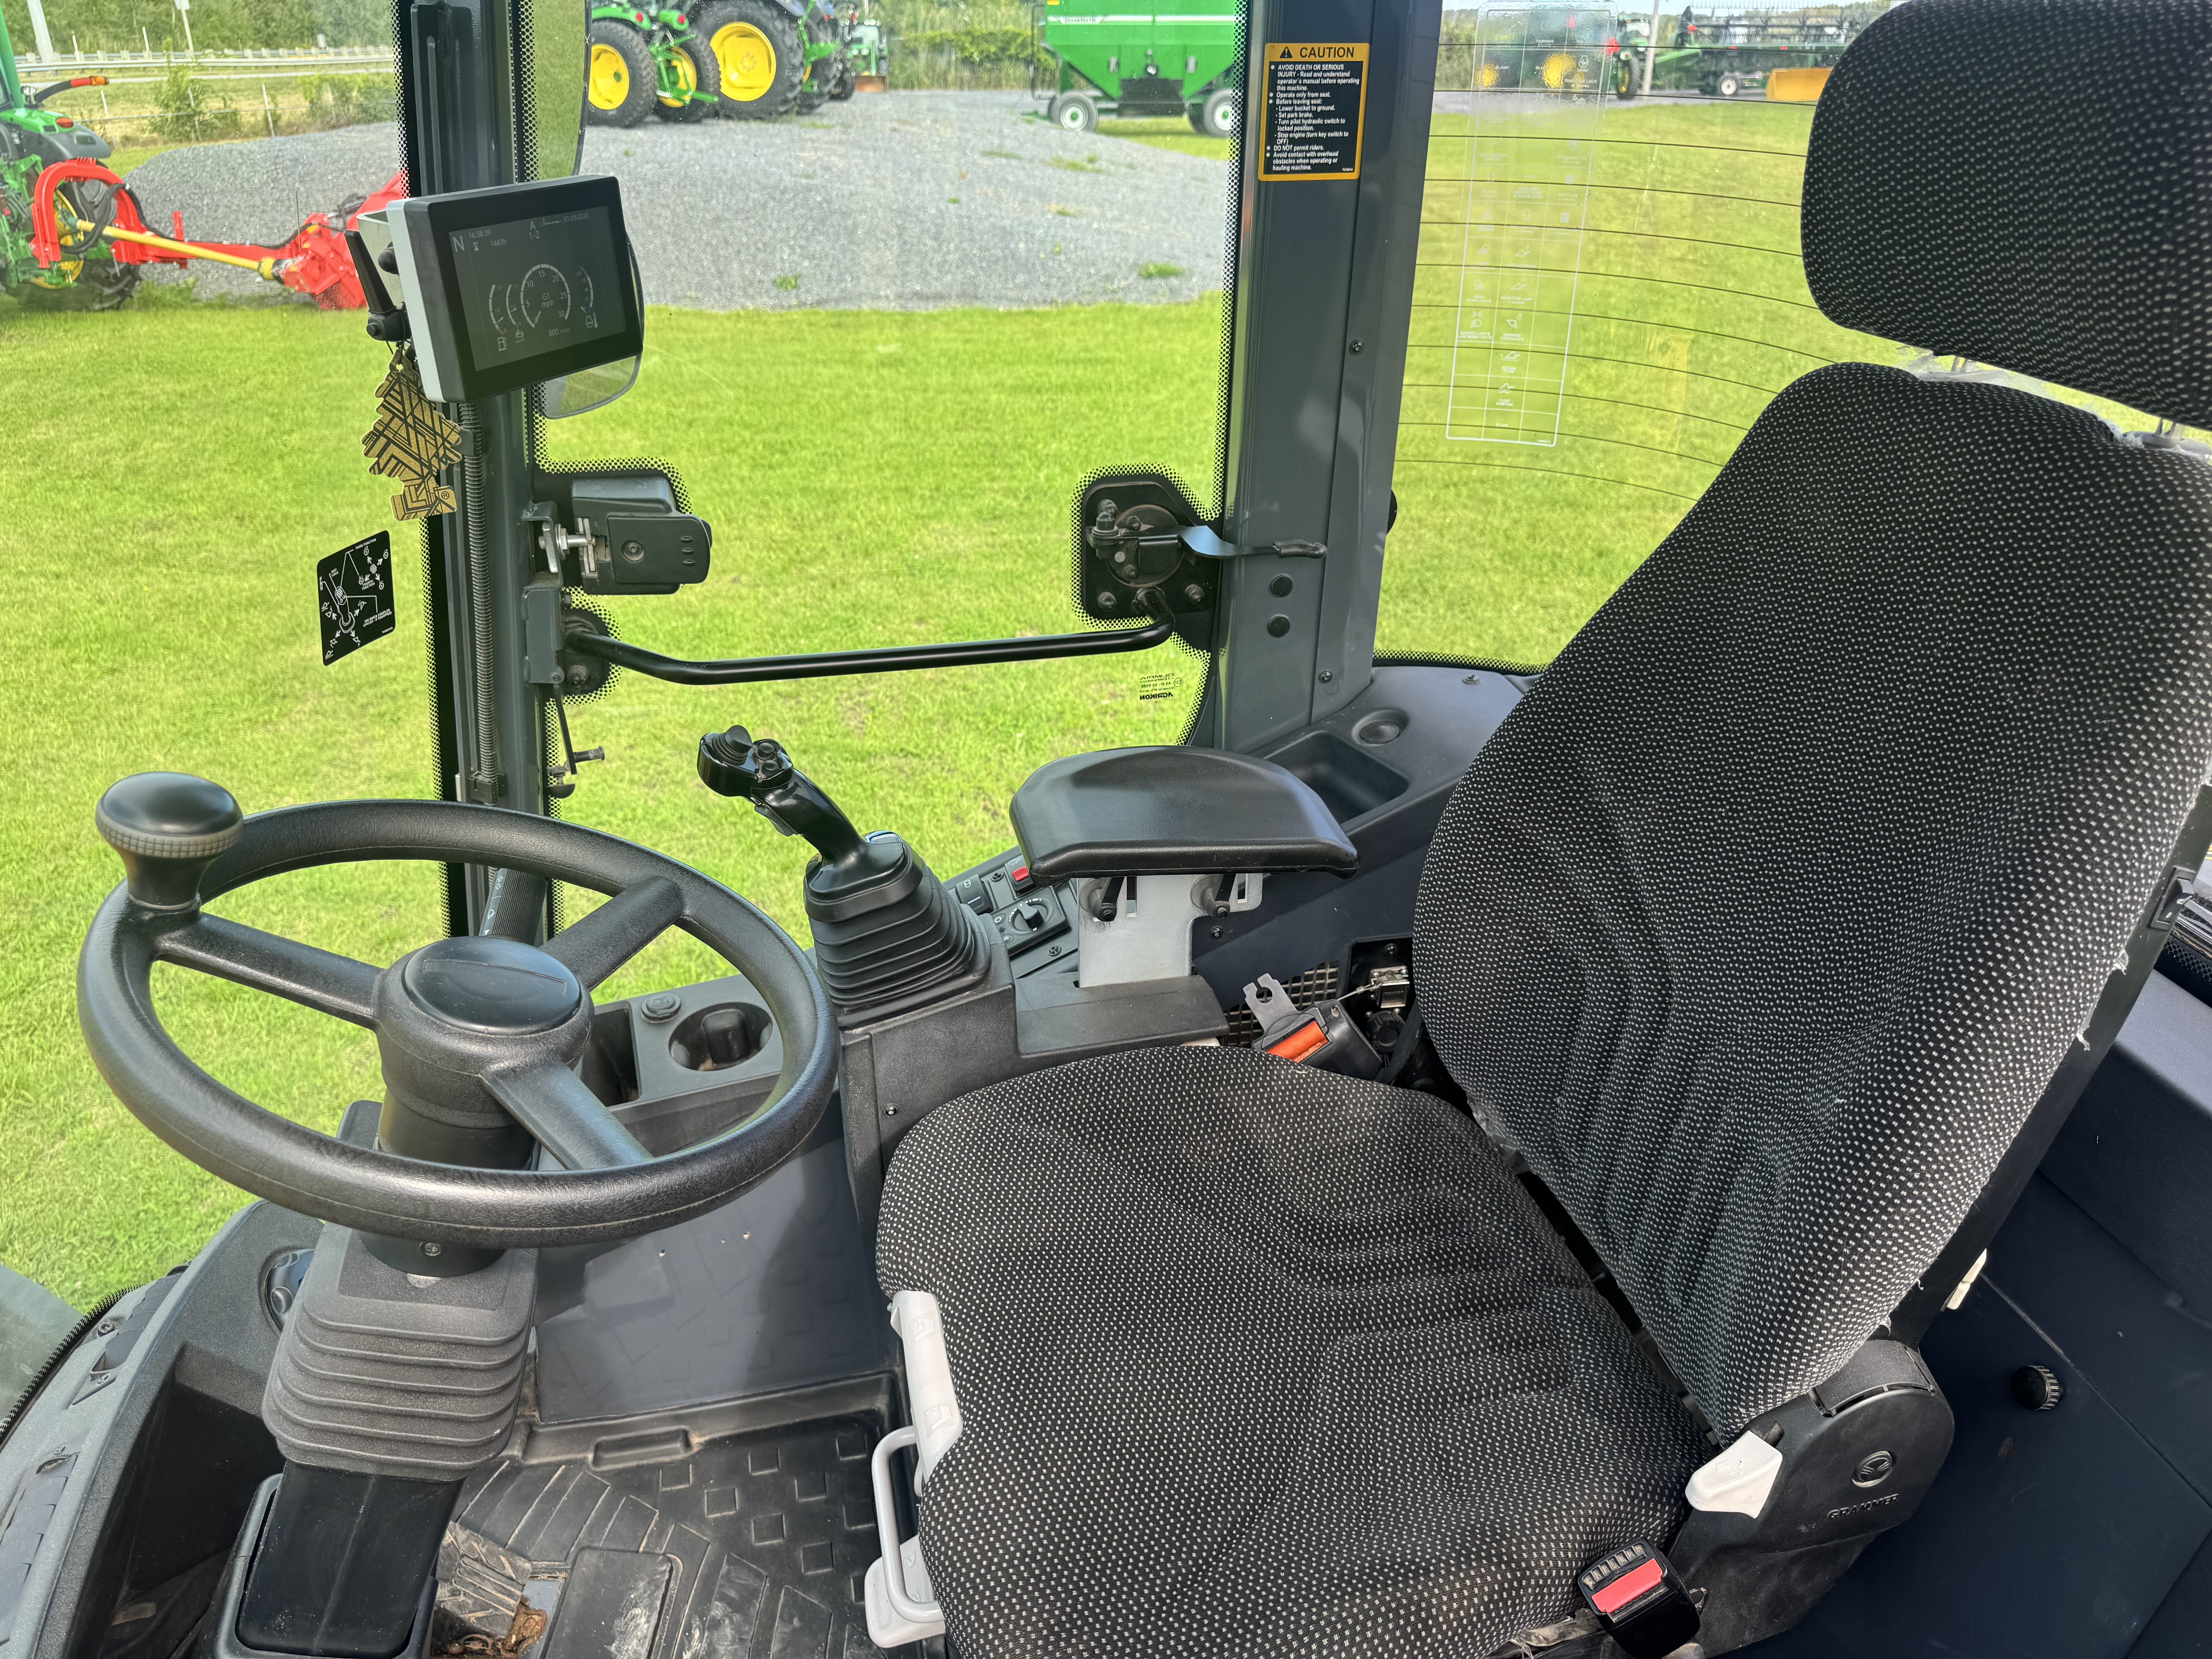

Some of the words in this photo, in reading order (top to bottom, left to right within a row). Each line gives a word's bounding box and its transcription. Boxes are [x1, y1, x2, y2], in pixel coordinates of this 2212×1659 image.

[1300, 47, 1354, 58] CAUTION
[531, 221, 536, 231] A
[529, 231, 540, 240] 1-2
[453, 235, 465, 252] N
[468, 229, 491, 239] 16:38:39
[491, 239, 507, 247] 1447h
[552, 275, 559, 283] 20
[541, 300, 554, 309] mph
[549, 328, 559, 337] 800
[1827, 1493, 1899, 1519] GRAMMER
